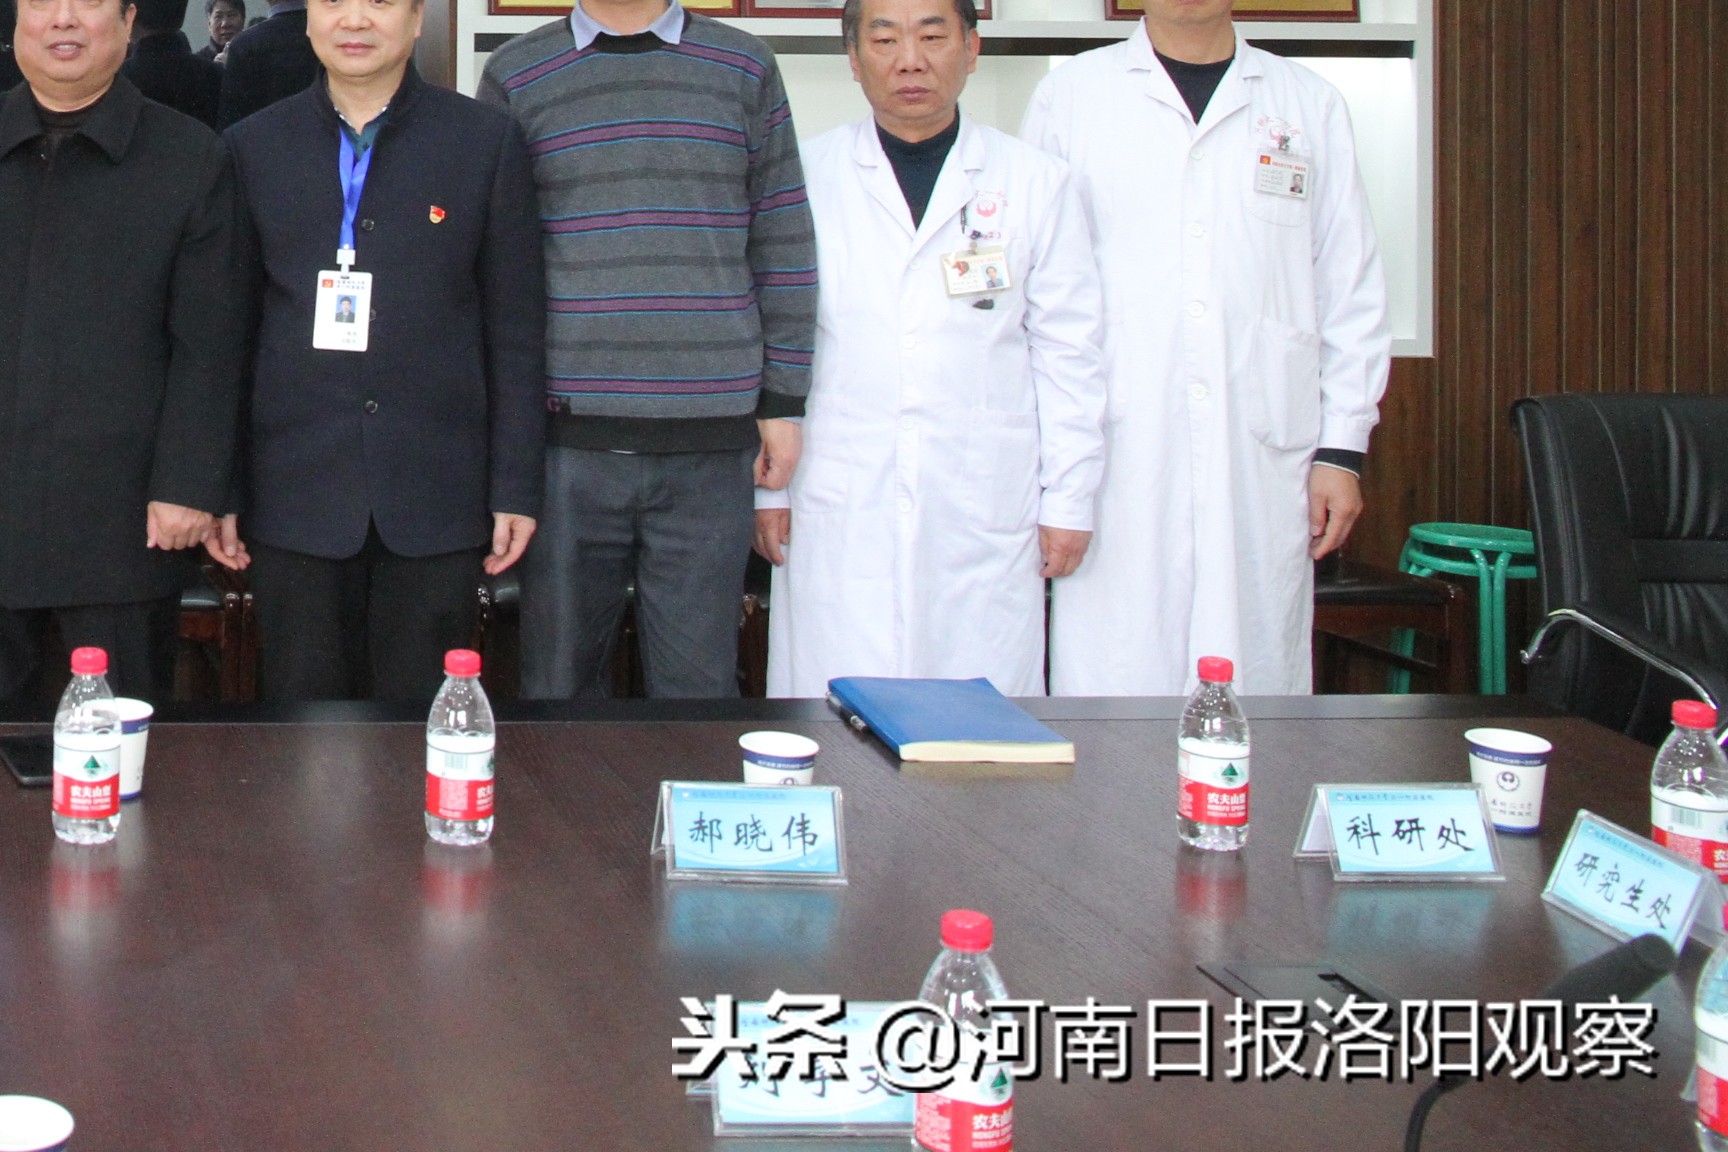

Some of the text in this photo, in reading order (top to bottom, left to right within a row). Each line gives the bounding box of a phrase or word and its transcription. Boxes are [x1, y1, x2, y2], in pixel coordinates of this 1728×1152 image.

[687, 810, 820, 857] 郝晓伟
[1346, 811, 1476, 856] 科研处
[1574, 851, 1673, 930] 研究生处
